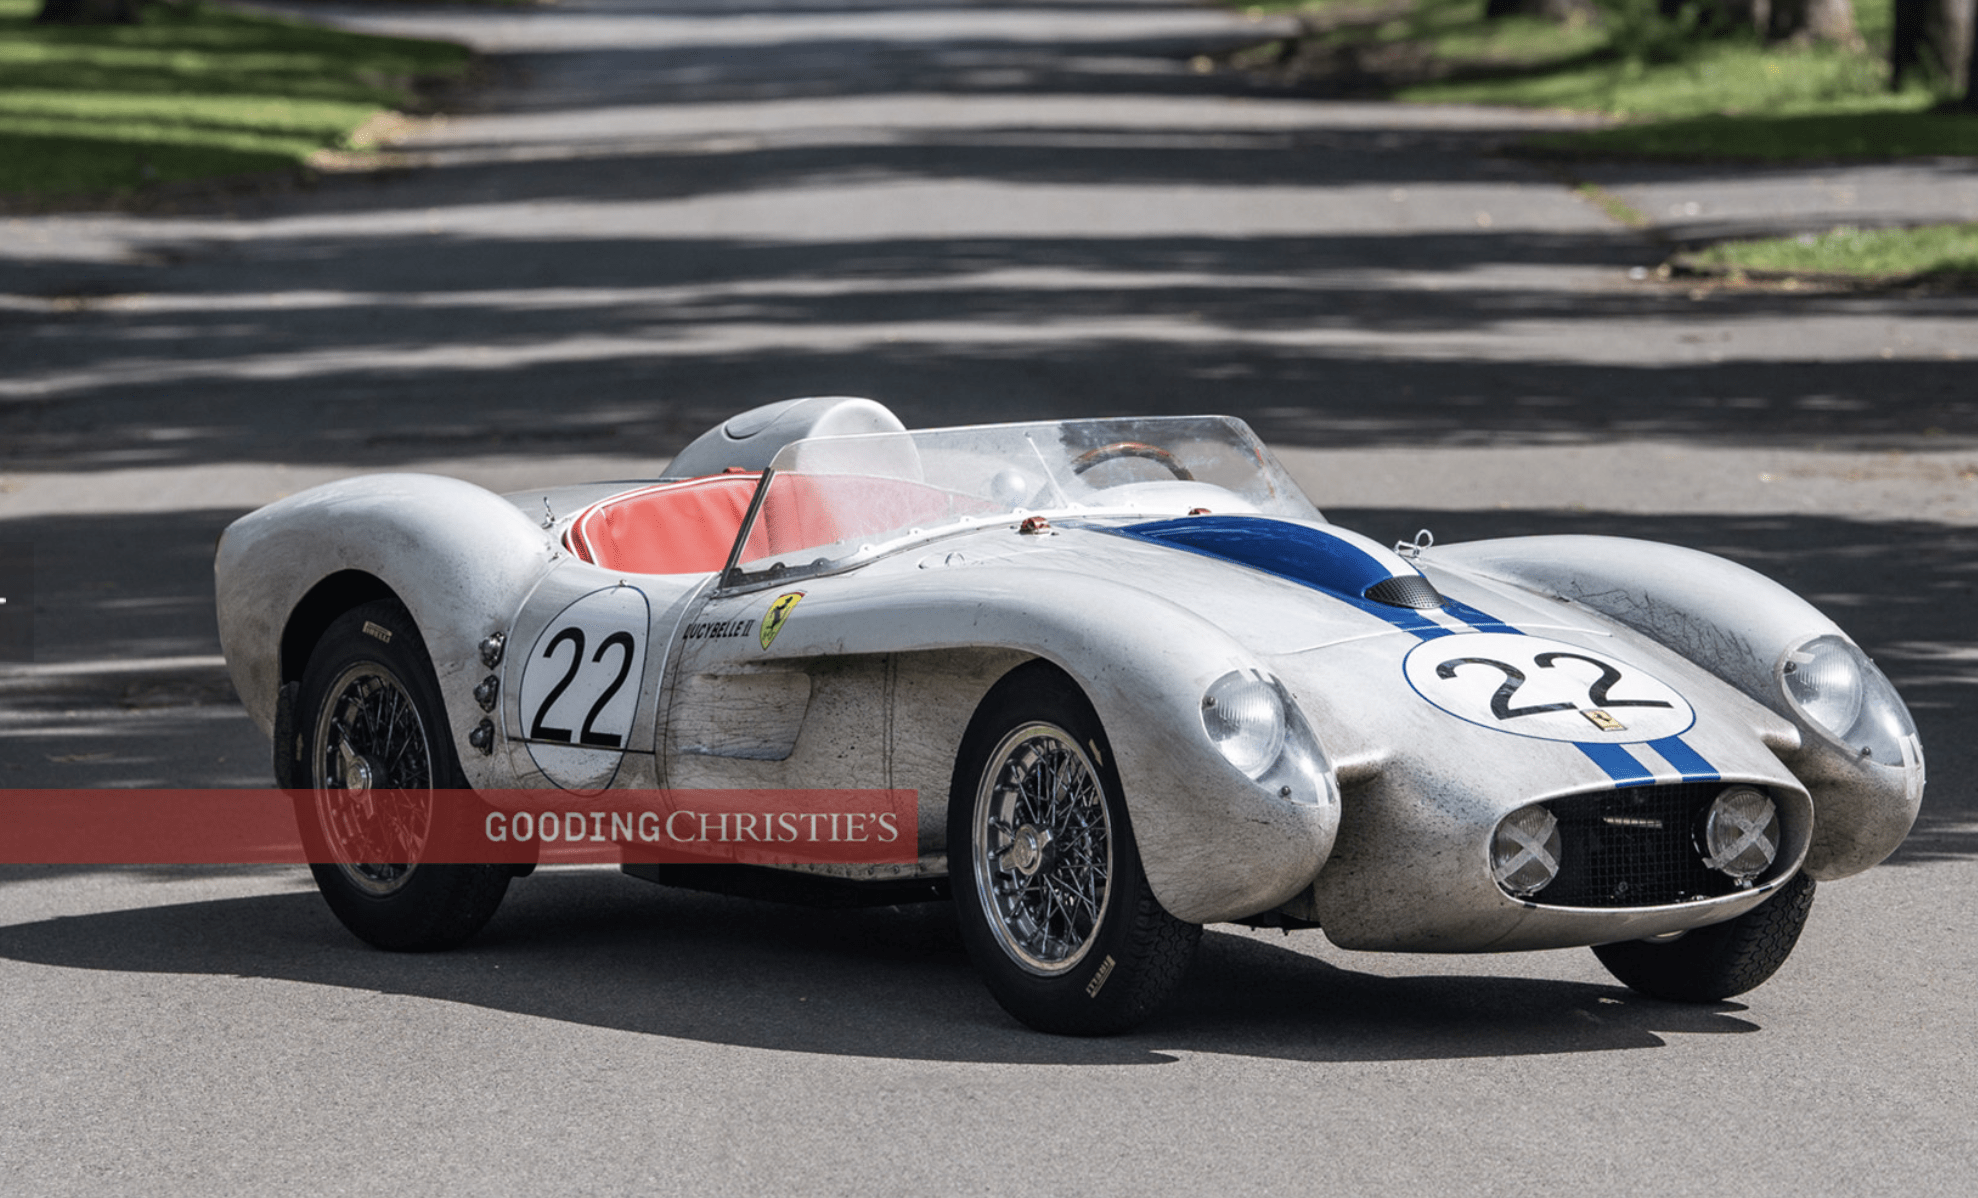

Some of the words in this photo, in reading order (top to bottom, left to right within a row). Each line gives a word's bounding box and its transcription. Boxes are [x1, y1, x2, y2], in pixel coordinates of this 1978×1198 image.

[682, 620, 744, 640] LUCYBELLE
[741, 619, 756, 637] II
[530, 626, 635, 748] 22
[1435, 652, 1674, 720] 22
